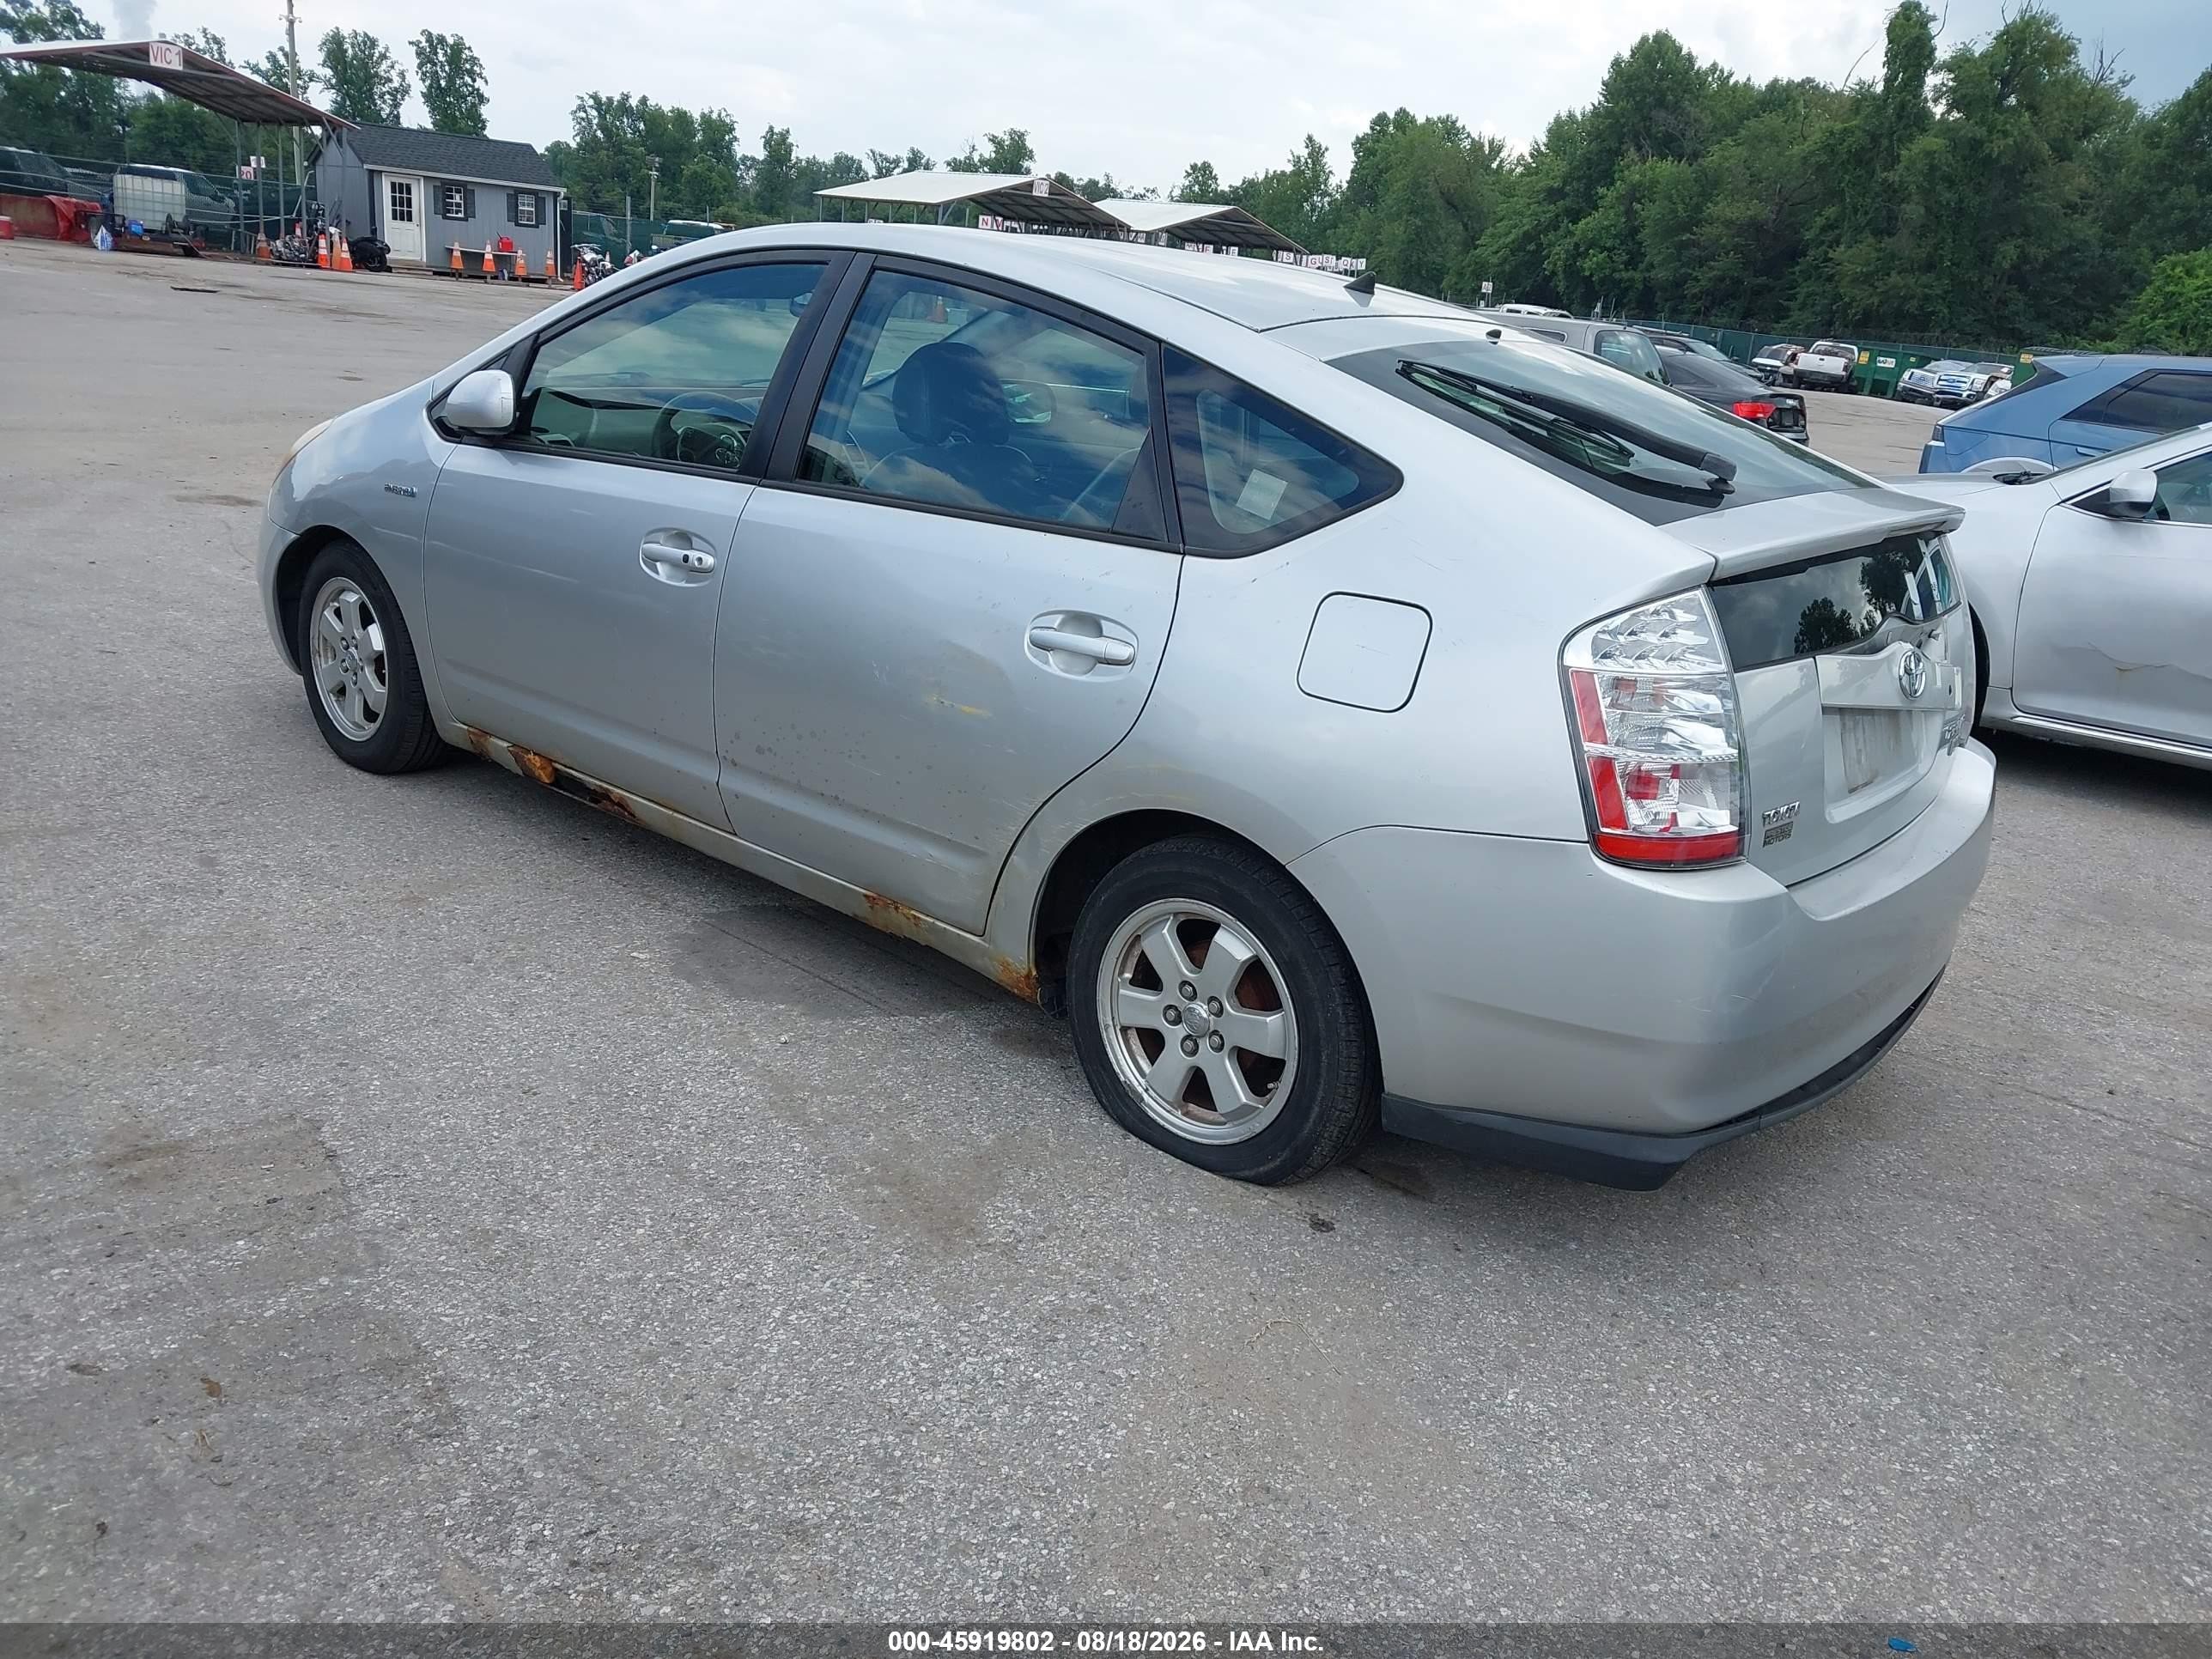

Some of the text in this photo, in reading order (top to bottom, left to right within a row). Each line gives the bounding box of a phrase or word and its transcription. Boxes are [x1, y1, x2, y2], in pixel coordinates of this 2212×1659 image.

[150, 44, 182, 67] VIC 1
[1034, 181, 1048, 194] VIC 2
[981, 217, 989, 228] N
[1285, 252, 1291, 261] S
